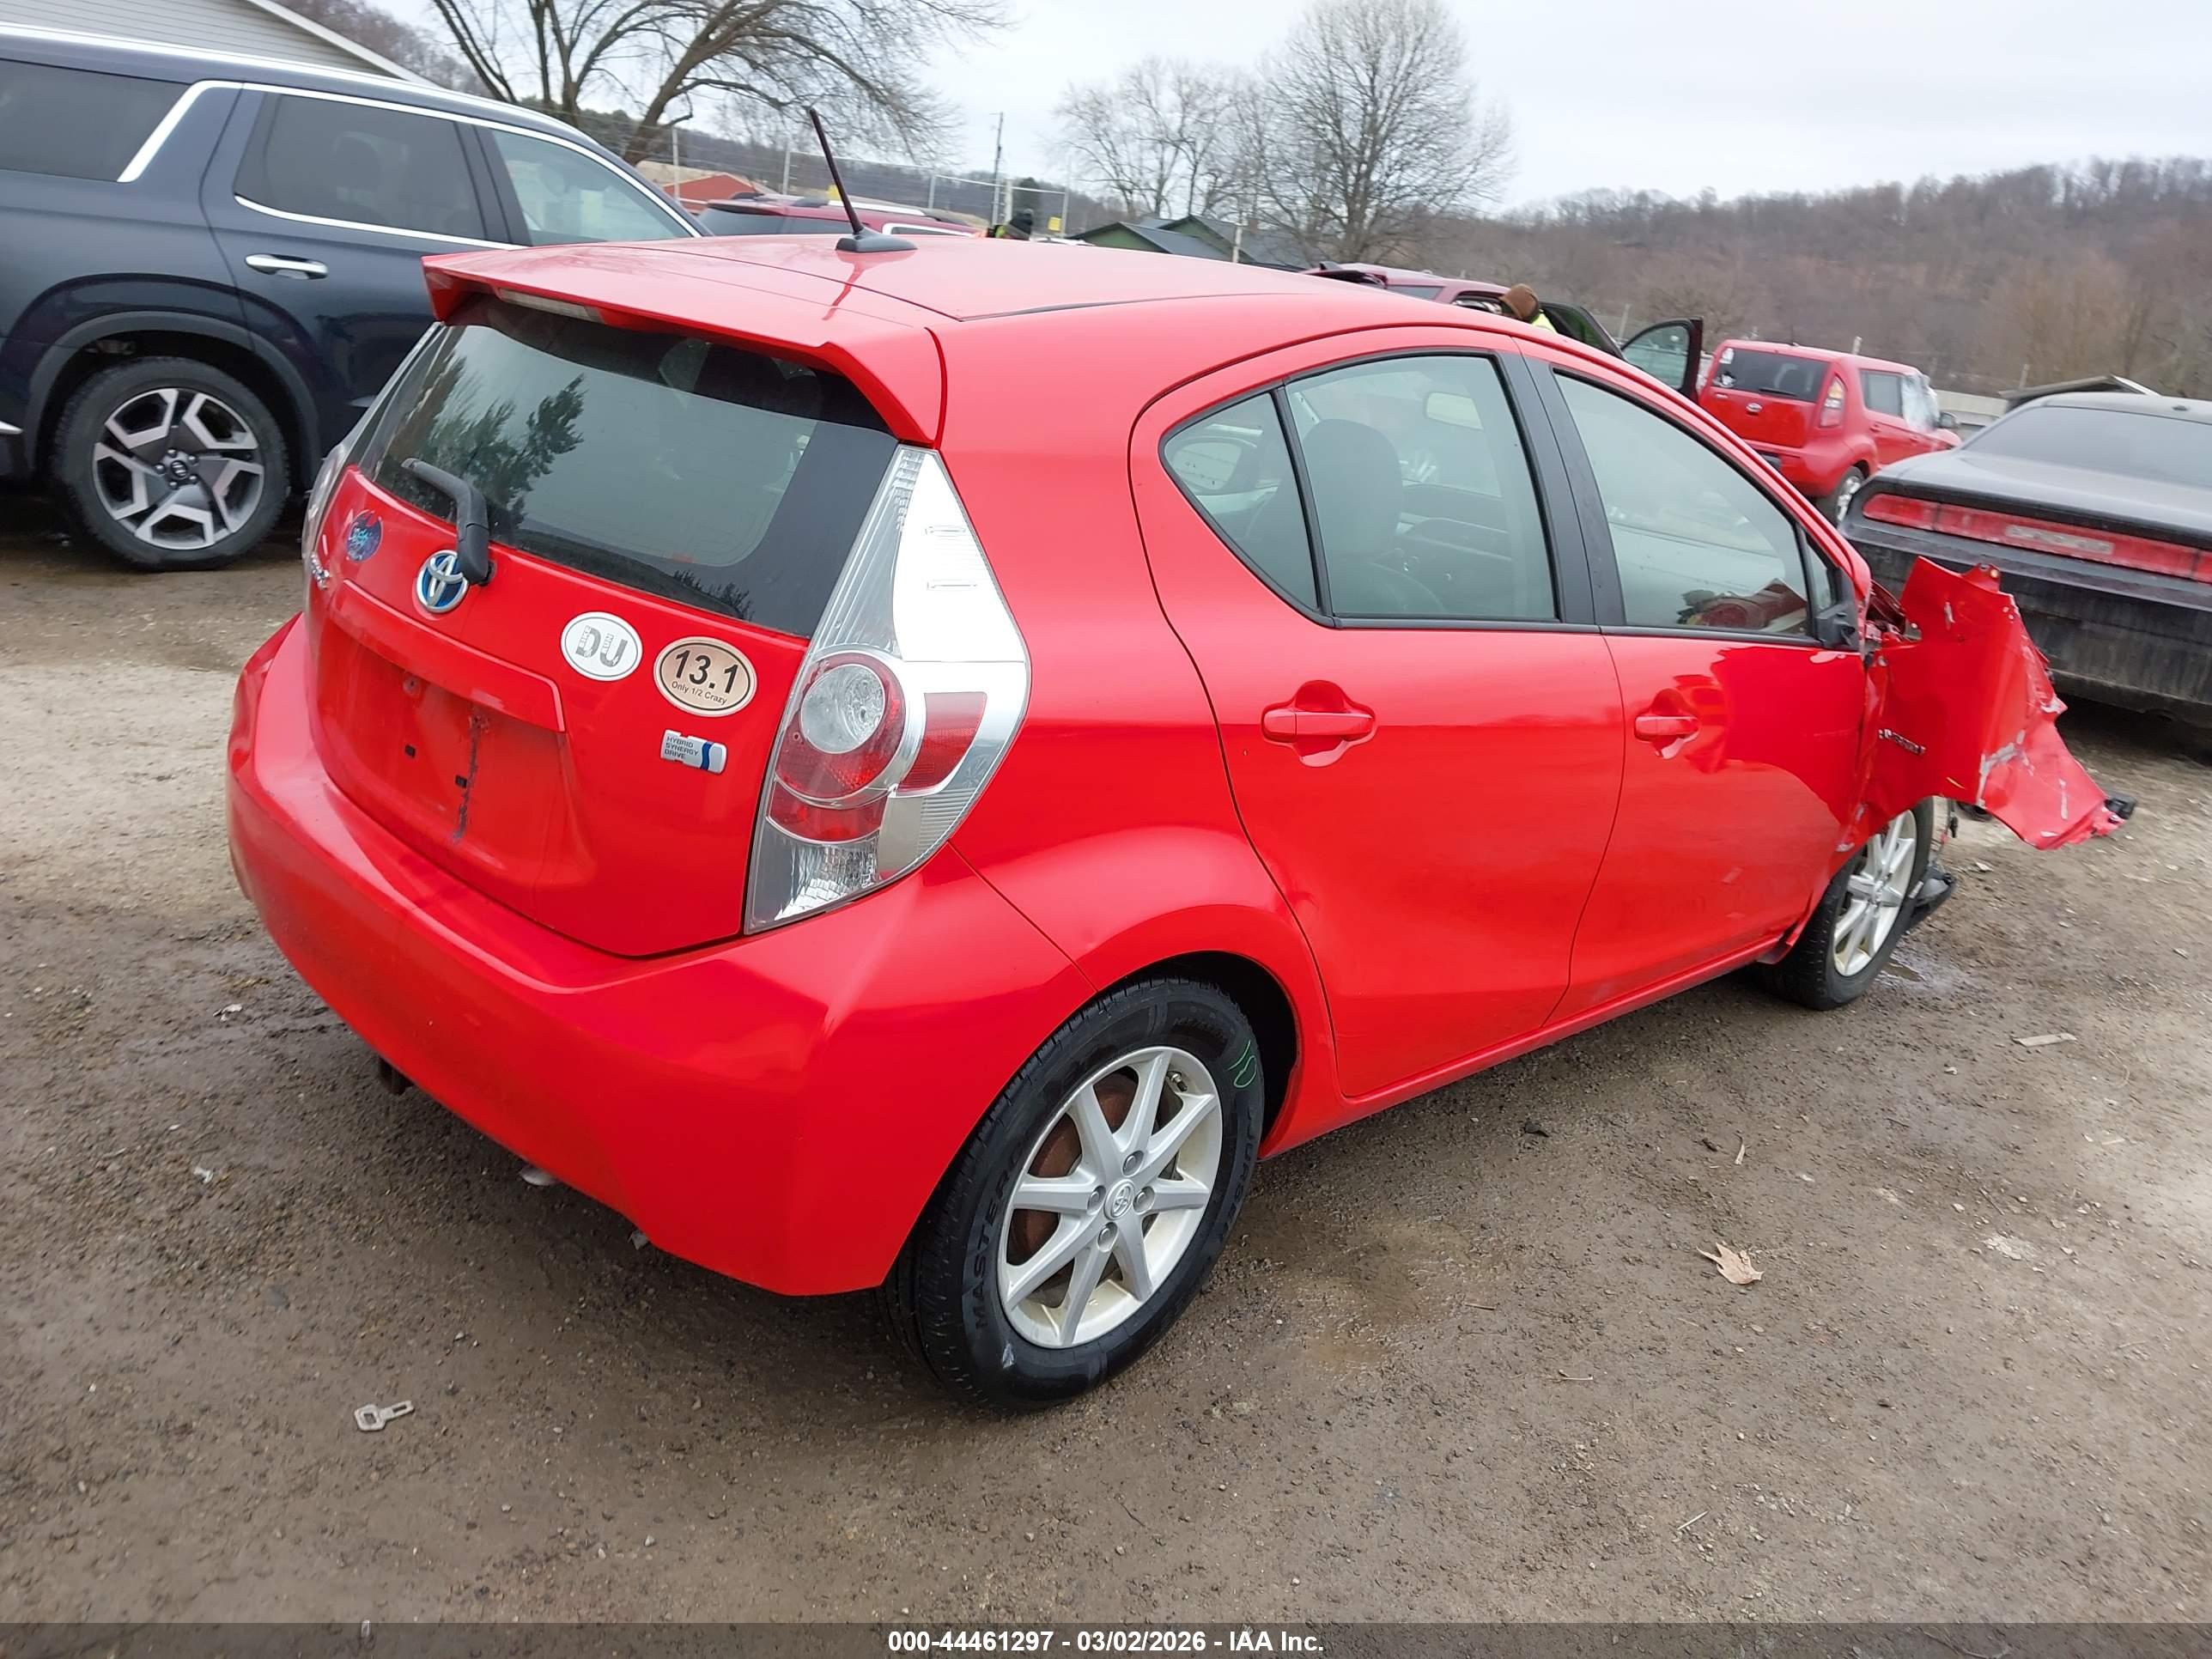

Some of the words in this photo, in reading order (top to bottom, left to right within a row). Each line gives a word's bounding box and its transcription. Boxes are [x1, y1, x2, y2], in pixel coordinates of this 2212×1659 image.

[675, 649, 738, 695] 13.1
[672, 681, 690, 694] Only
[691, 688, 703, 698] 1/2
[704, 691, 727, 706] Crazy
[666, 736, 694, 749] HYBRID
[664, 749, 687, 760] DRIVE
[665, 743, 699, 757] SYNERGY
